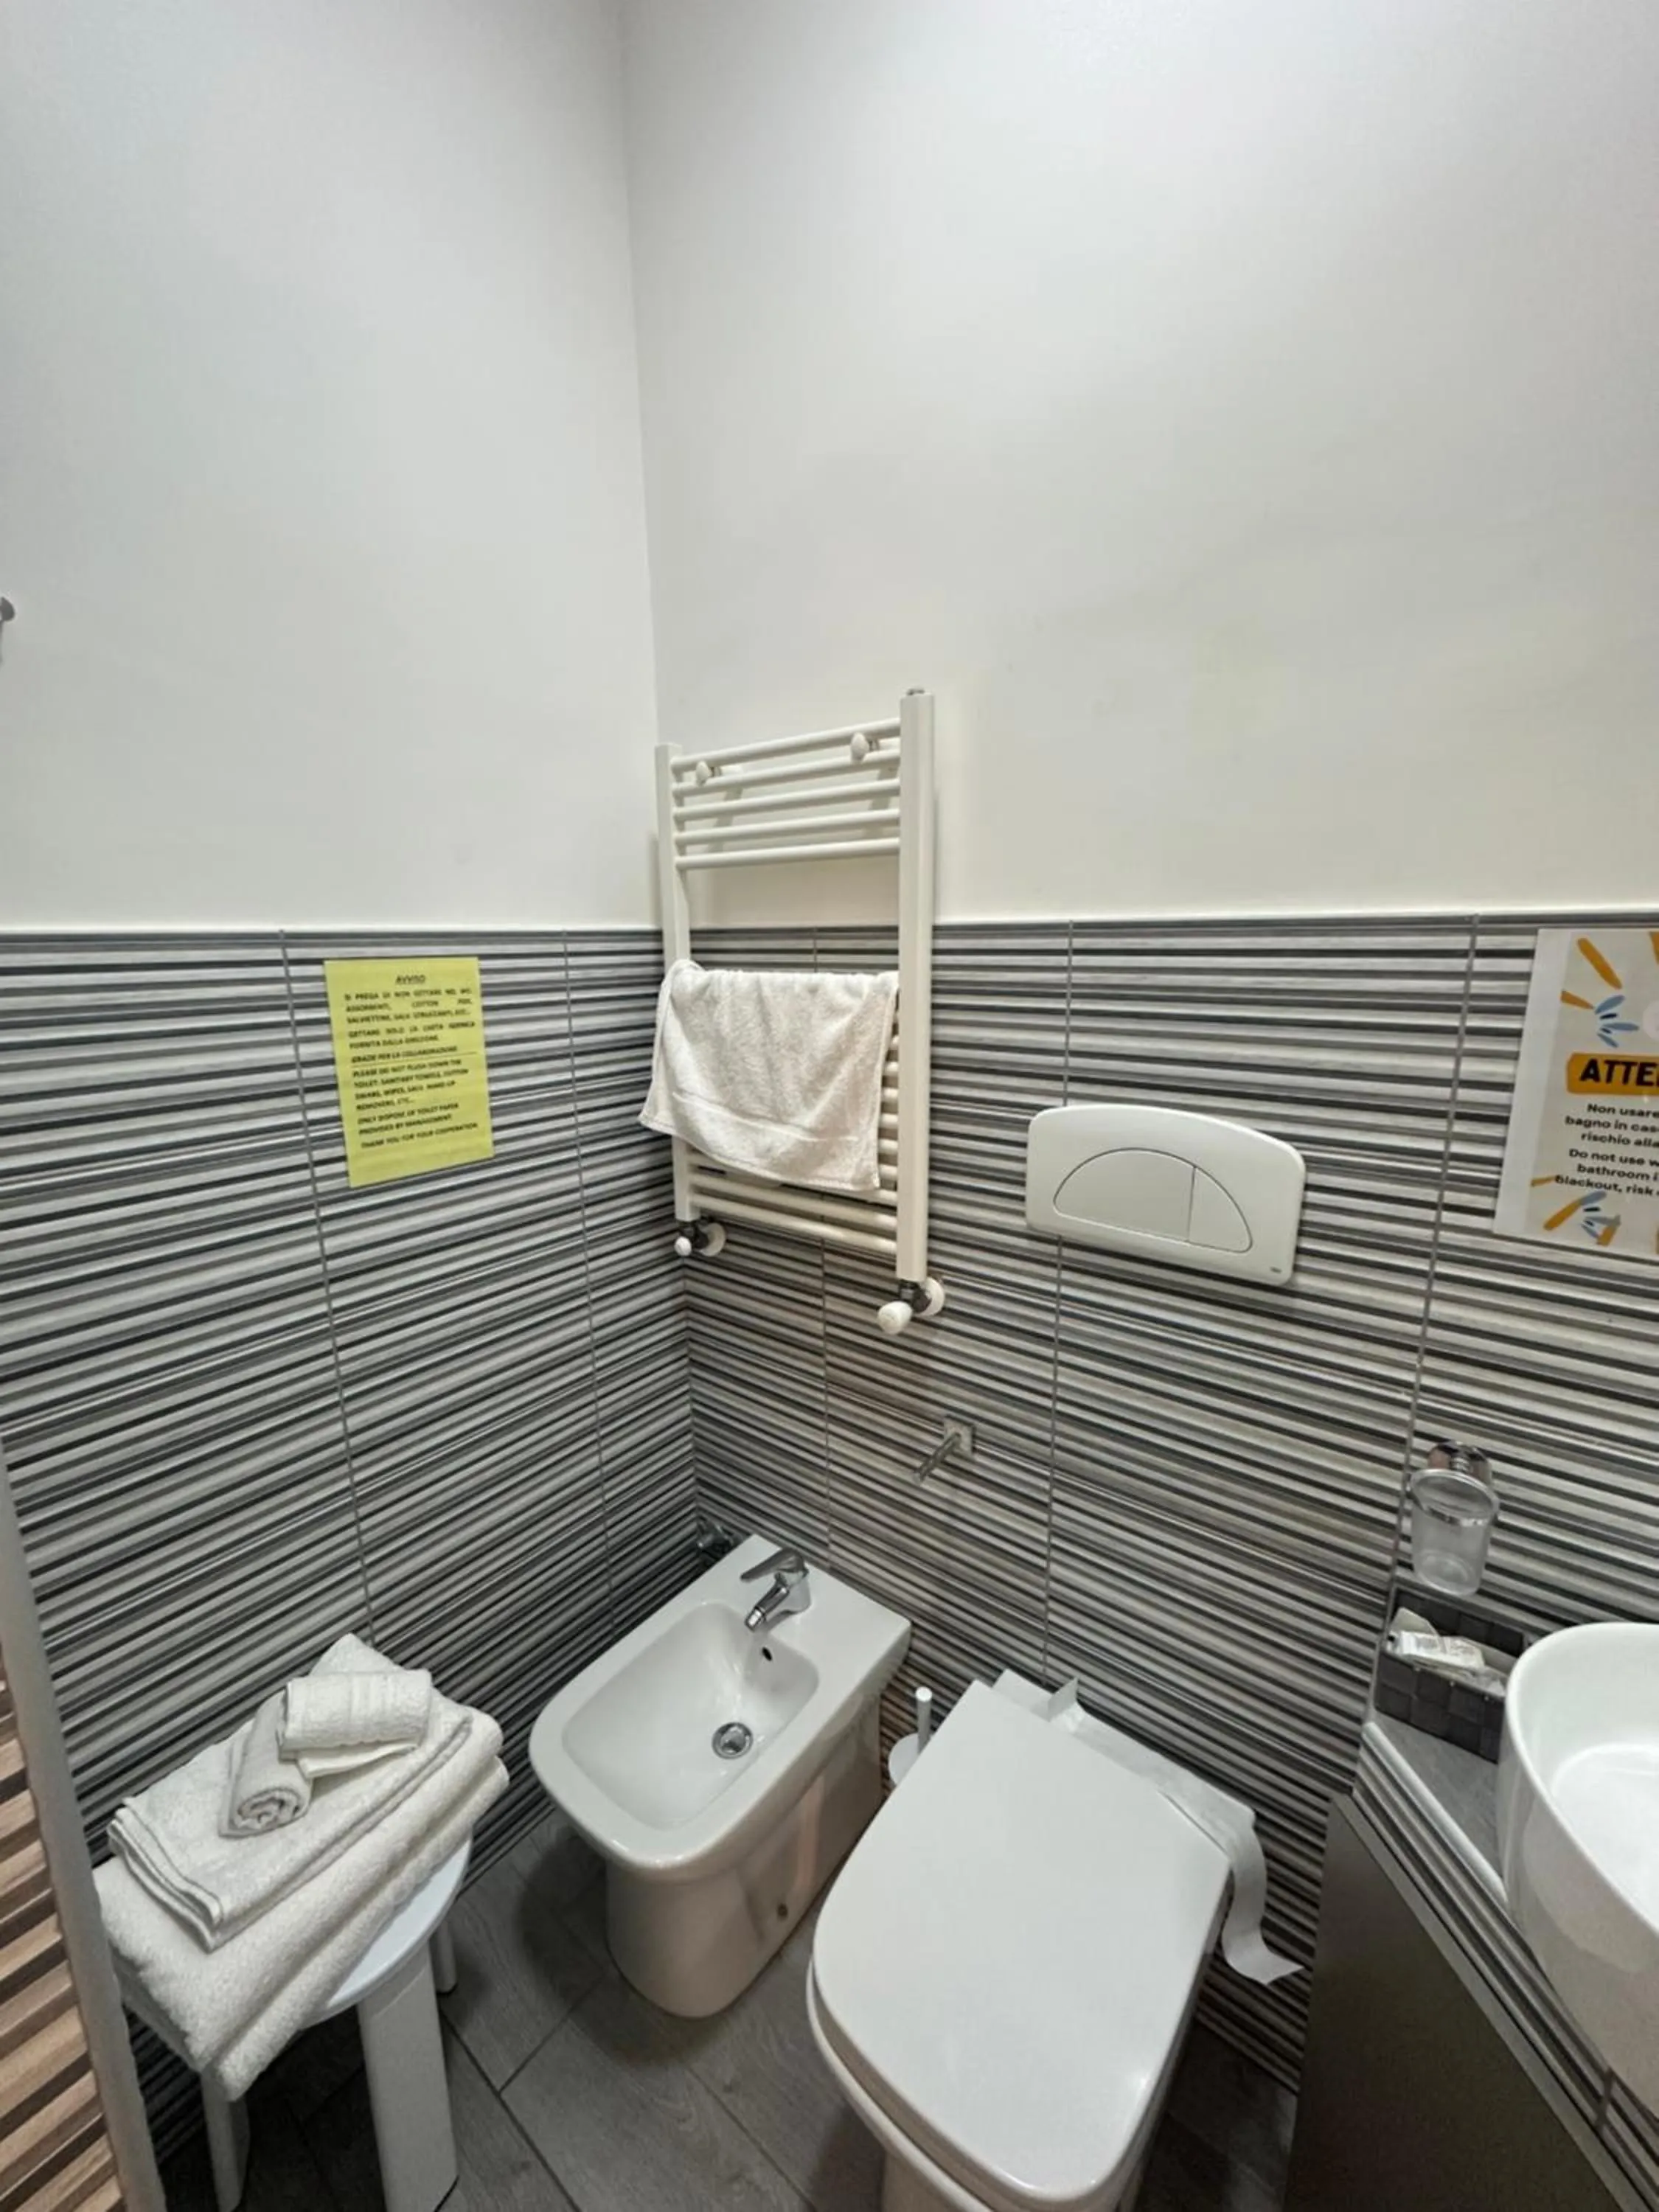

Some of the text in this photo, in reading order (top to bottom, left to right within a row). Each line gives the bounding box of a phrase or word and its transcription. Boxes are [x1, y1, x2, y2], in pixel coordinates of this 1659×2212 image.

[395, 974, 425, 984] AVVISO
[355, 992, 378, 1000] PREGA
[352, 1069, 377, 1077] PLEASE
[428, 1060, 448, 1068] DOWN
[1579, 1058, 1659, 1087] ATTE
[1587, 1103, 1616, 1115] Non
[358, 1116, 376, 1124] ONLY
[1565, 1115, 1659, 1133] bagno in cas
[1581, 1132, 1631, 1146] rischio
[1569, 1148, 1588, 1158] Do
[1591, 1152, 1616, 1163] not
[1619, 1156, 1645, 1166] use
[1576, 1163, 1650, 1180] bathroom
[1554, 1174, 1623, 1193] blackout,
[1626, 1184, 1653, 1195] risk
